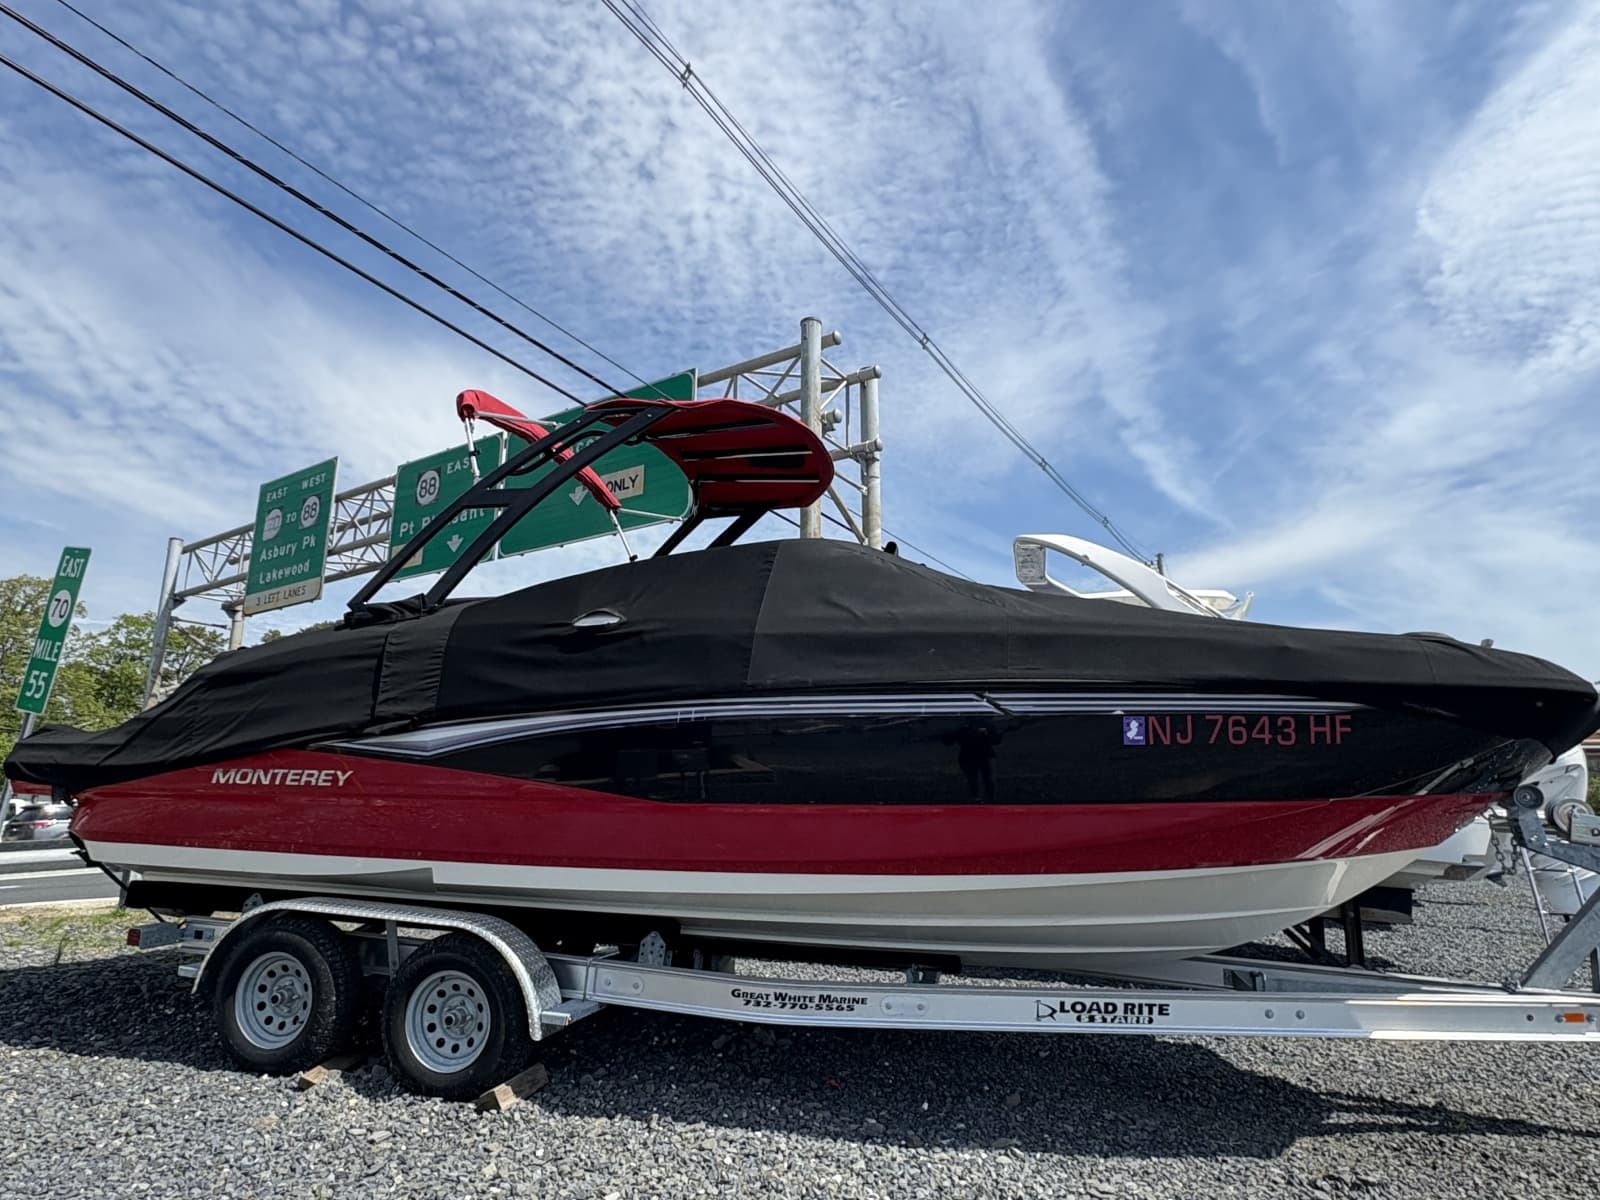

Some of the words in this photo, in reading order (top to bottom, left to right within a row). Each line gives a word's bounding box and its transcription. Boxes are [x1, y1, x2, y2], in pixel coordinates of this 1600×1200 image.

[446, 457, 475, 474] EAS
[266, 487, 289, 502] EAST
[301, 472, 327, 490] WEST
[419, 476, 436, 498] 88
[607, 474, 639, 493] ONLY
[285, 512, 297, 524] TO
[303, 502, 318, 521] 88
[400, 520, 415, 537] Pt
[260, 541, 298, 563] Asbury
[302, 534, 317, 549] Pk
[59, 555, 85, 578] EAST
[259, 559, 311, 584] Lakewood
[263, 591, 280, 605] LEFT
[282, 585, 307, 601] LANES
[51, 598, 69, 618] 70
[33, 638, 62, 662] MILE
[25, 670, 48, 699] 55
[1148, 714, 1193, 745] NJ
[1205, 714, 1297, 746] 7643
[1309, 714, 1352, 745] HF
[210, 768, 354, 787] MONTEREY
[1059, 1000, 1118, 1014] LOAD
[1123, 1002, 1170, 1016] RITE
